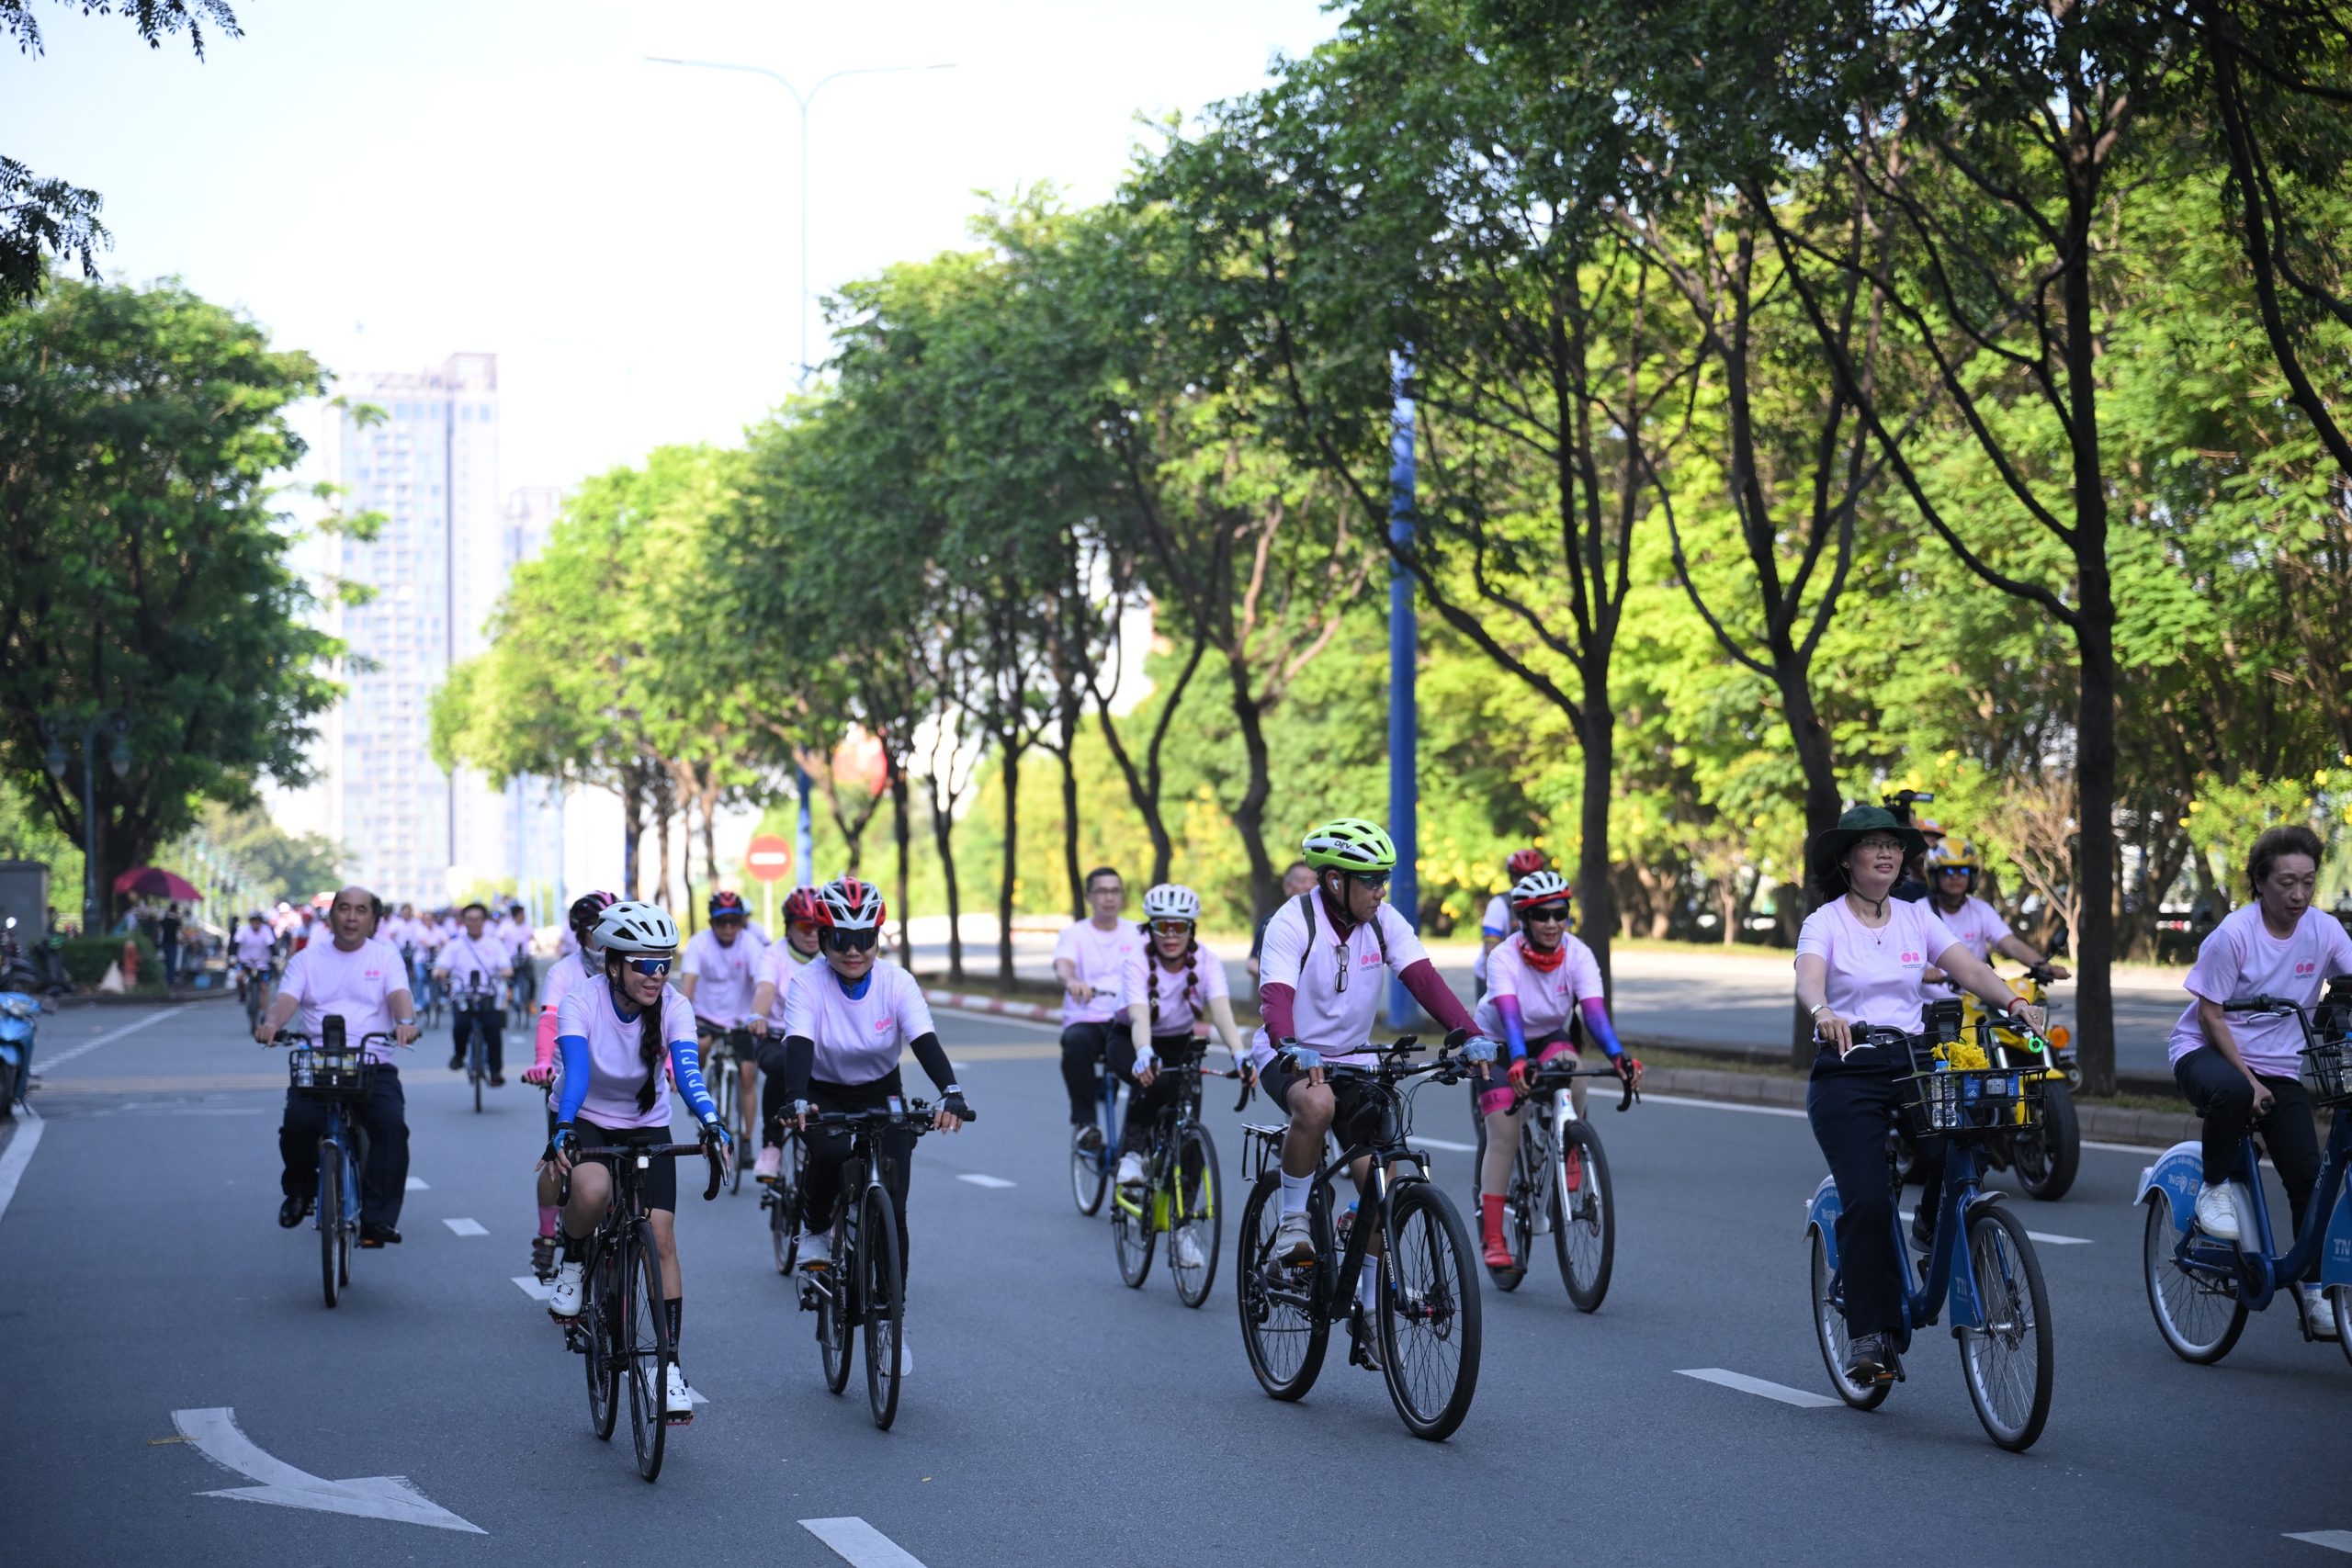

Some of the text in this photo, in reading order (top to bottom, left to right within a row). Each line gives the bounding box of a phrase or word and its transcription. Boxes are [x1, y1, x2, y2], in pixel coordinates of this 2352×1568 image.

[1334, 840, 1352, 850] DEV
[2167, 1173, 2188, 1194] TNGO
[2333, 1238, 2351, 1256] TN
[1954, 1276, 1968, 1296] TN
